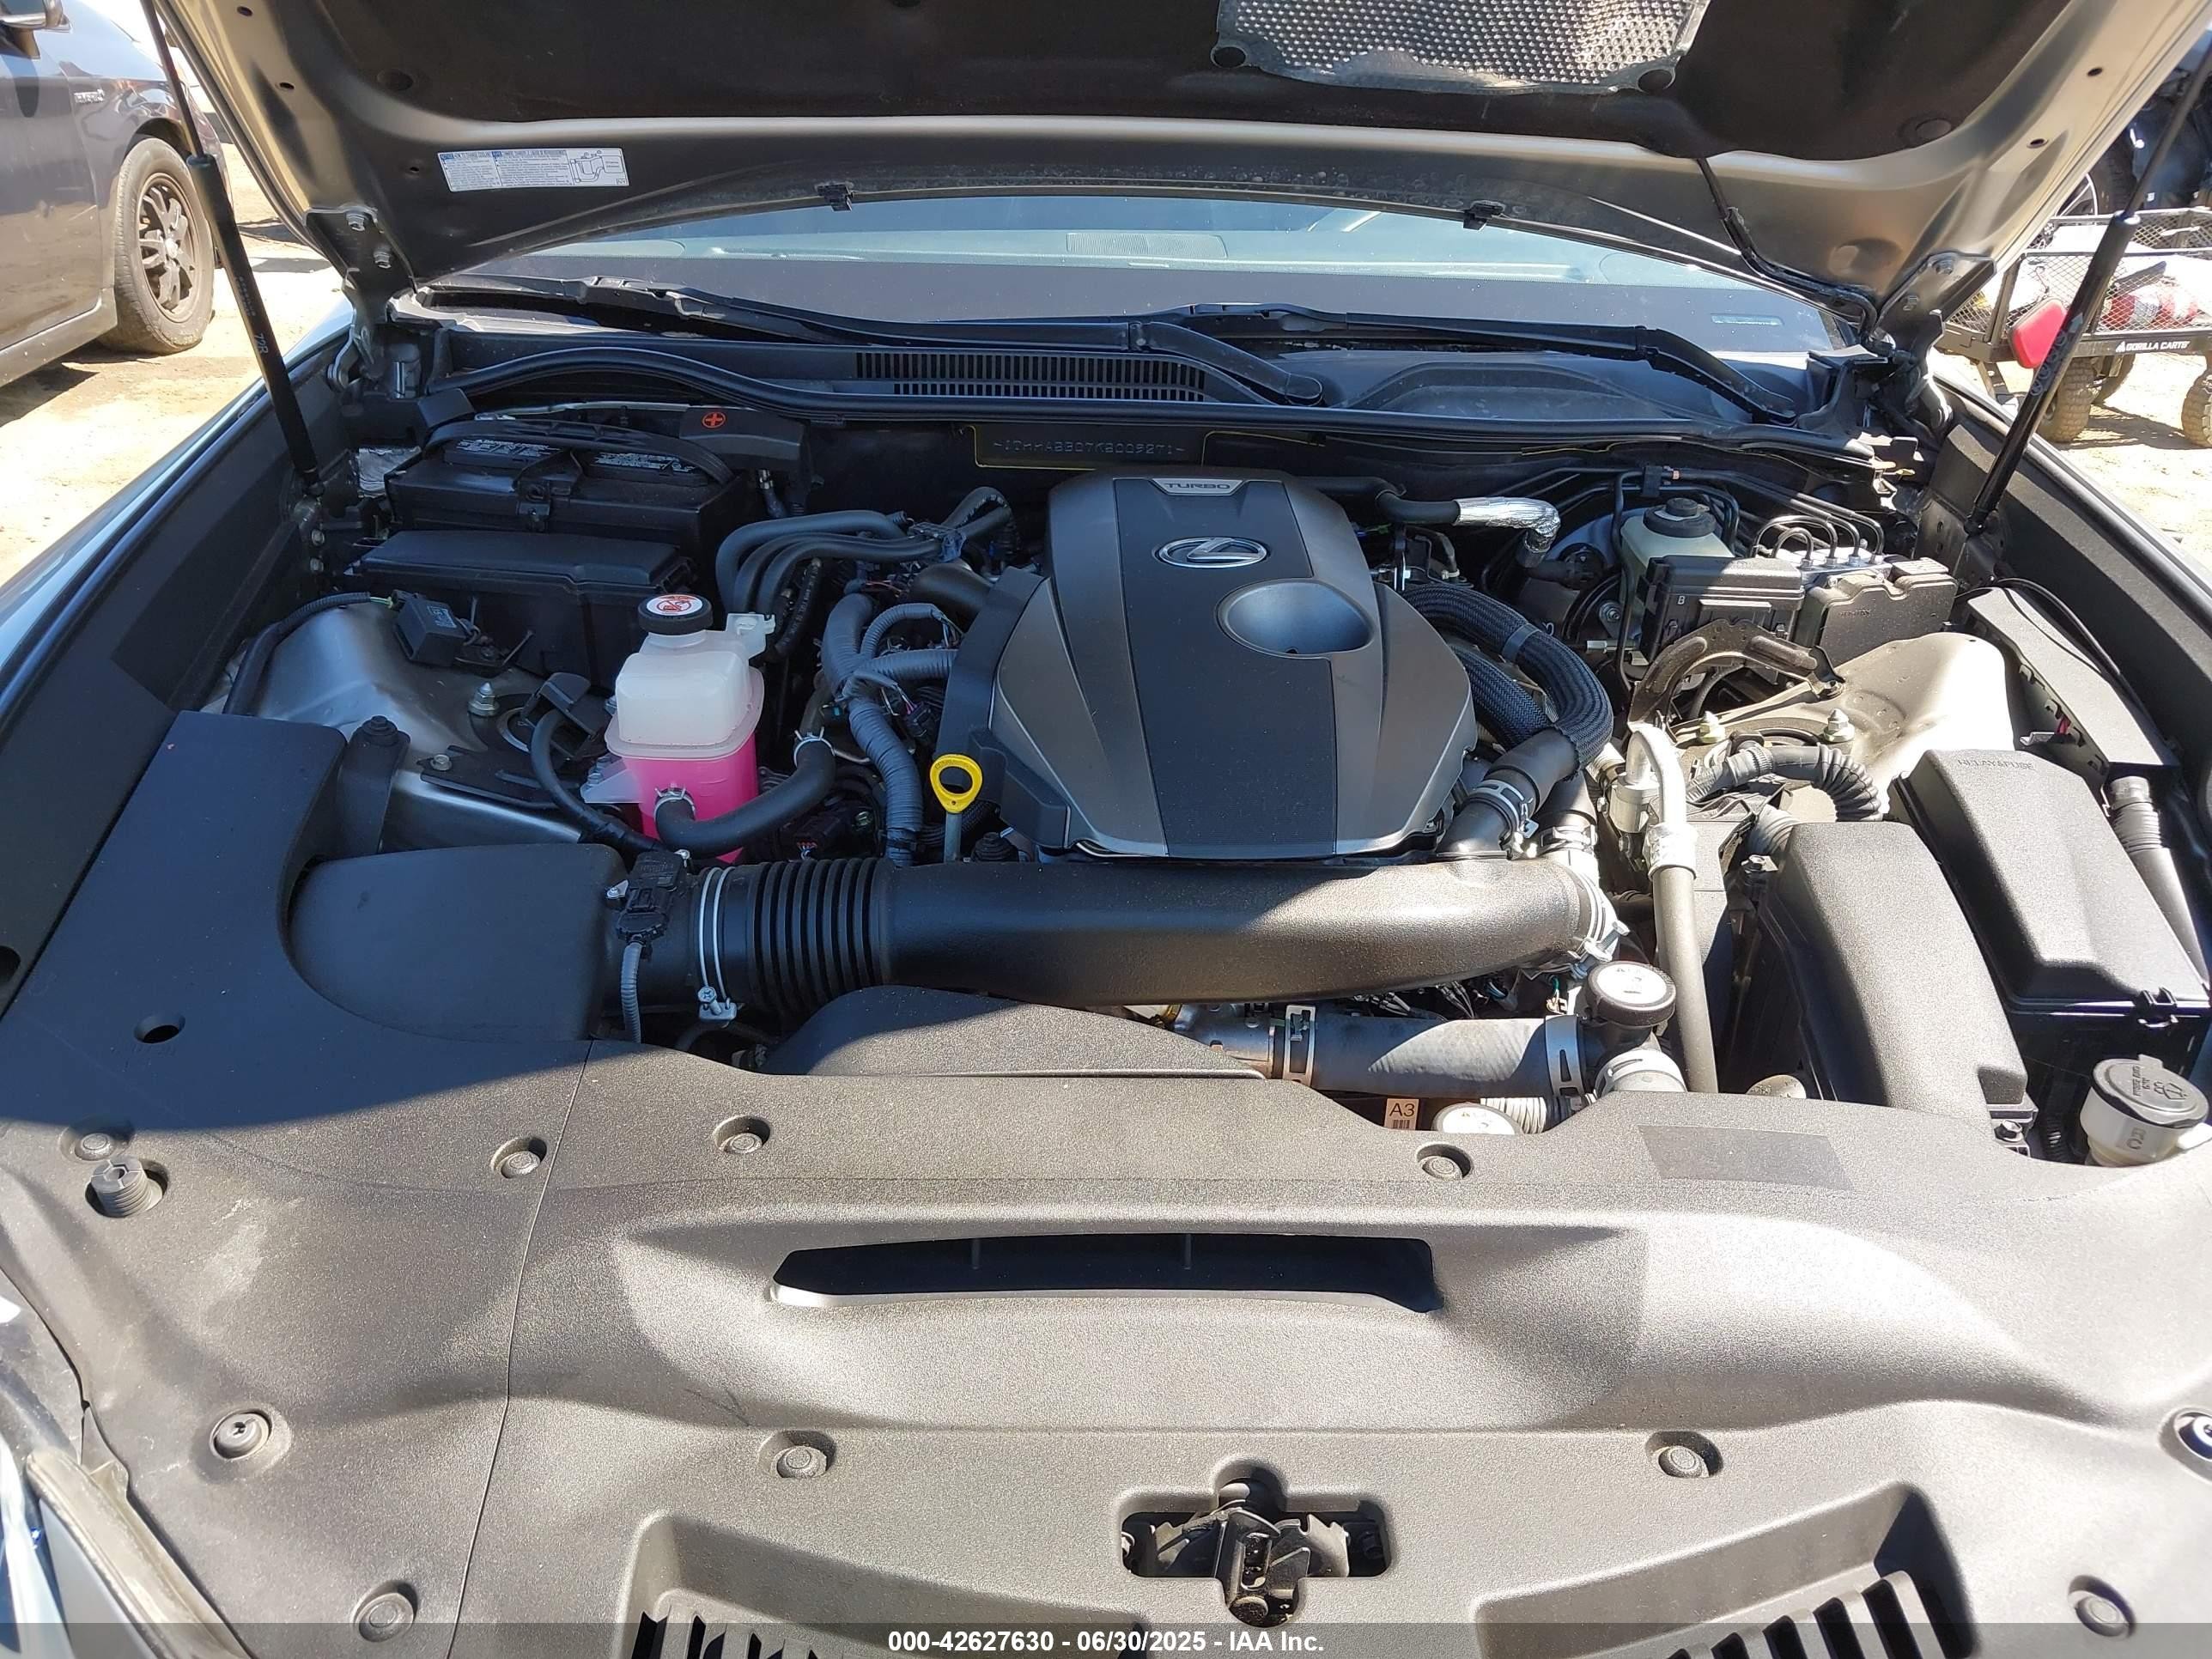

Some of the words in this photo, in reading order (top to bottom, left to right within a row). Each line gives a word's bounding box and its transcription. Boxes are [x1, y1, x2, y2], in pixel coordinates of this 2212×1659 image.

[2125, 342, 2160, 351] GORILLA
[1677, 595, 1686, 605] B
[1389, 1103, 1415, 1117] A3
